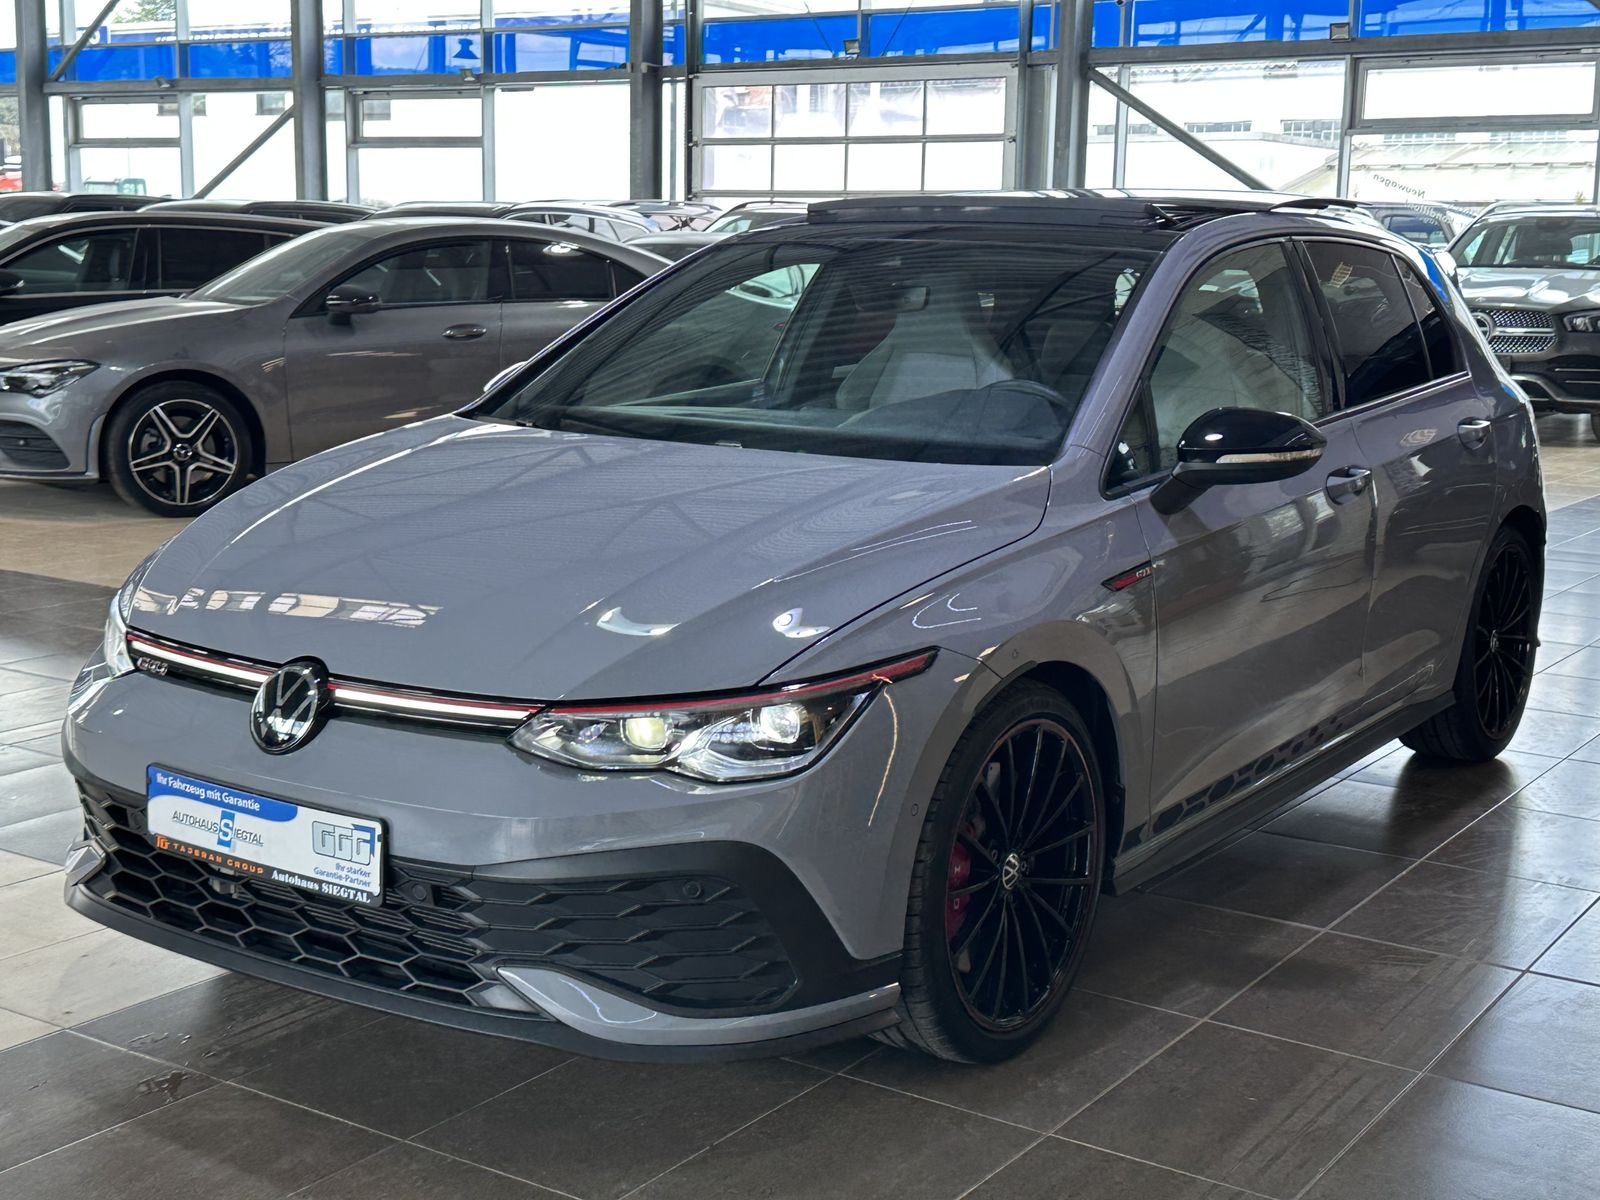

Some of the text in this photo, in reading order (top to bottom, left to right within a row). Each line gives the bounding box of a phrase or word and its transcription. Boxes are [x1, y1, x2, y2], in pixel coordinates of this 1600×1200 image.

[156, 772, 261, 812] Ihr Fahrzeug mit Garantie
[172, 811, 219, 834] AUTOHAUS
[226, 858, 265, 875] GROUP
[313, 867, 372, 888] Garantie-Partner
[335, 862, 372, 879] Ihr starker
[271, 869, 372, 904] Autohaus SIEGTAL
